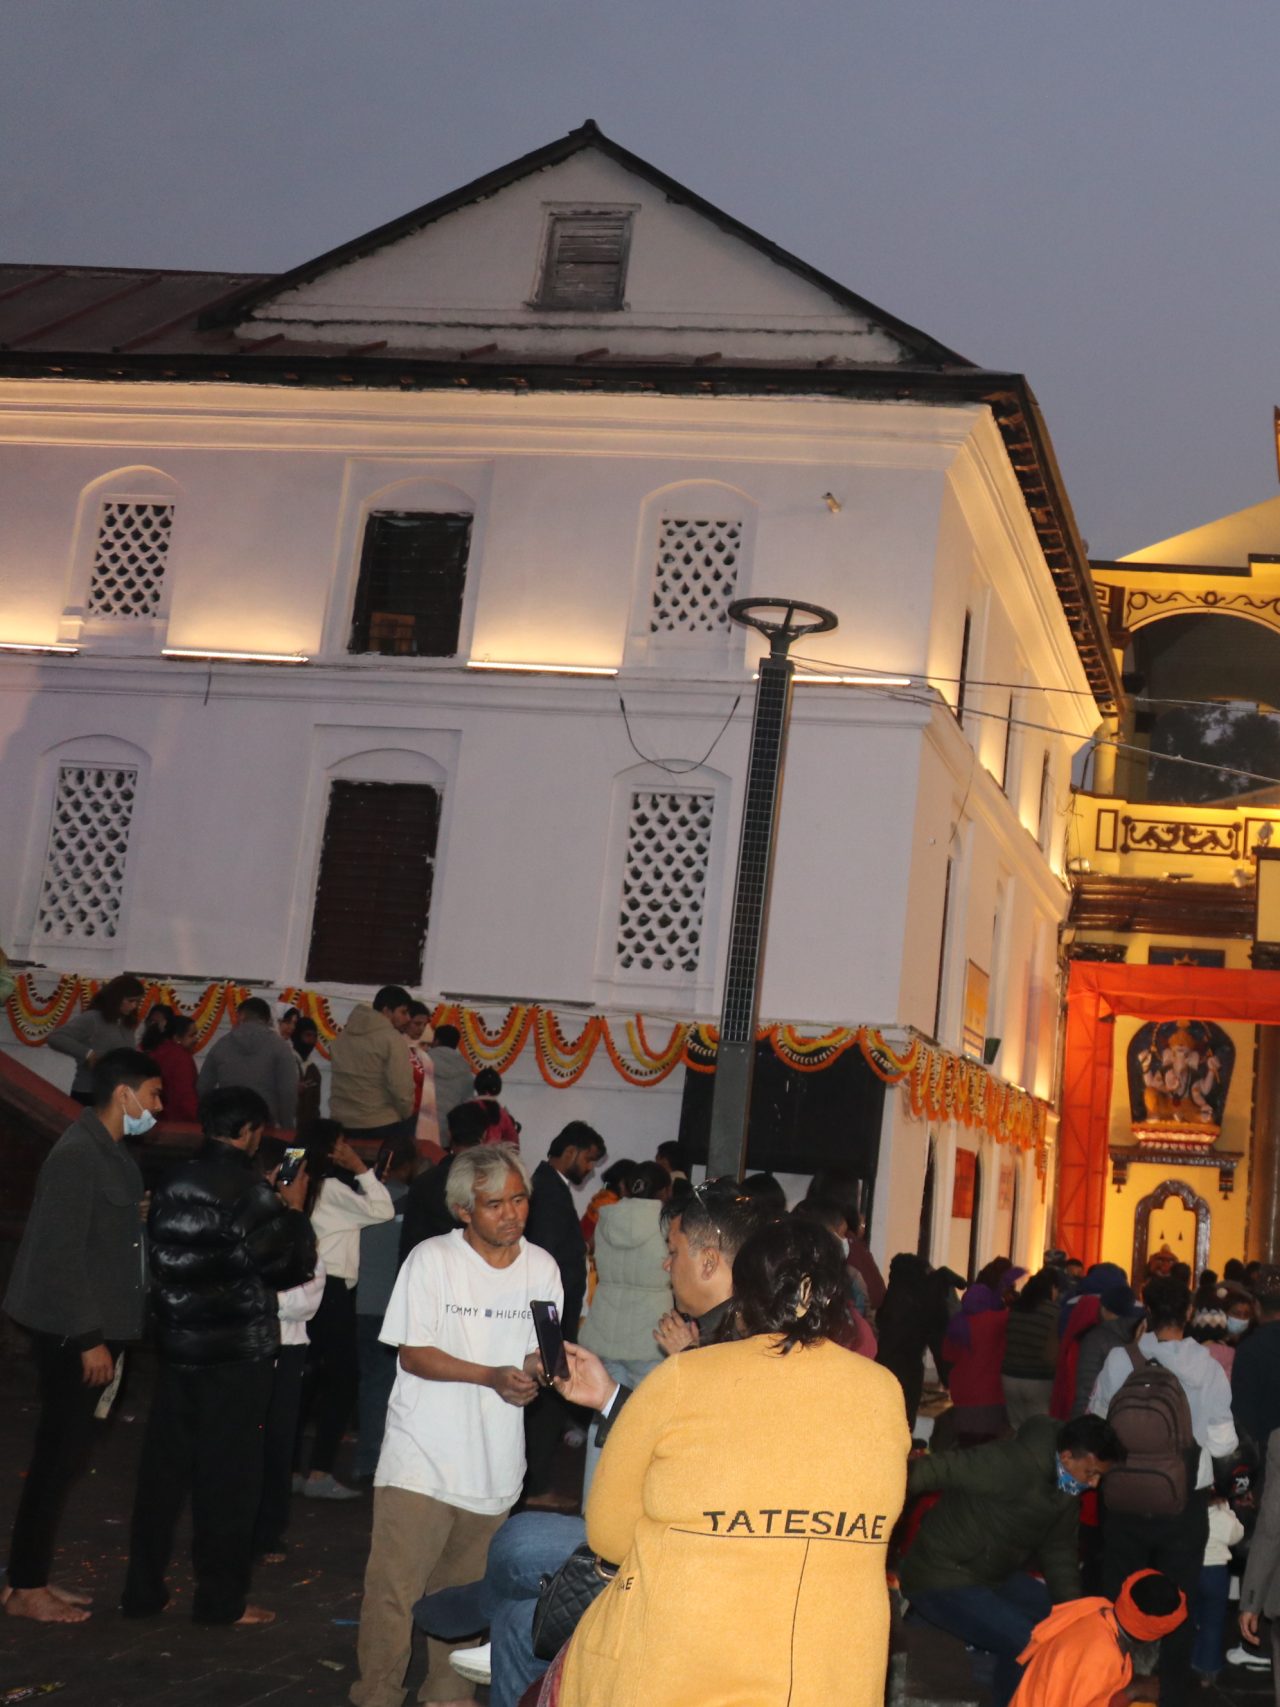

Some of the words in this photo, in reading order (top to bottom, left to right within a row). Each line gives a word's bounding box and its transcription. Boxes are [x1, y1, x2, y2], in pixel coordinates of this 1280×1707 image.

[445, 1304, 478, 1316] TOMMY
[496, 1309, 532, 1320] HILFIGE
[703, 1509, 887, 1539] TATESIAE
